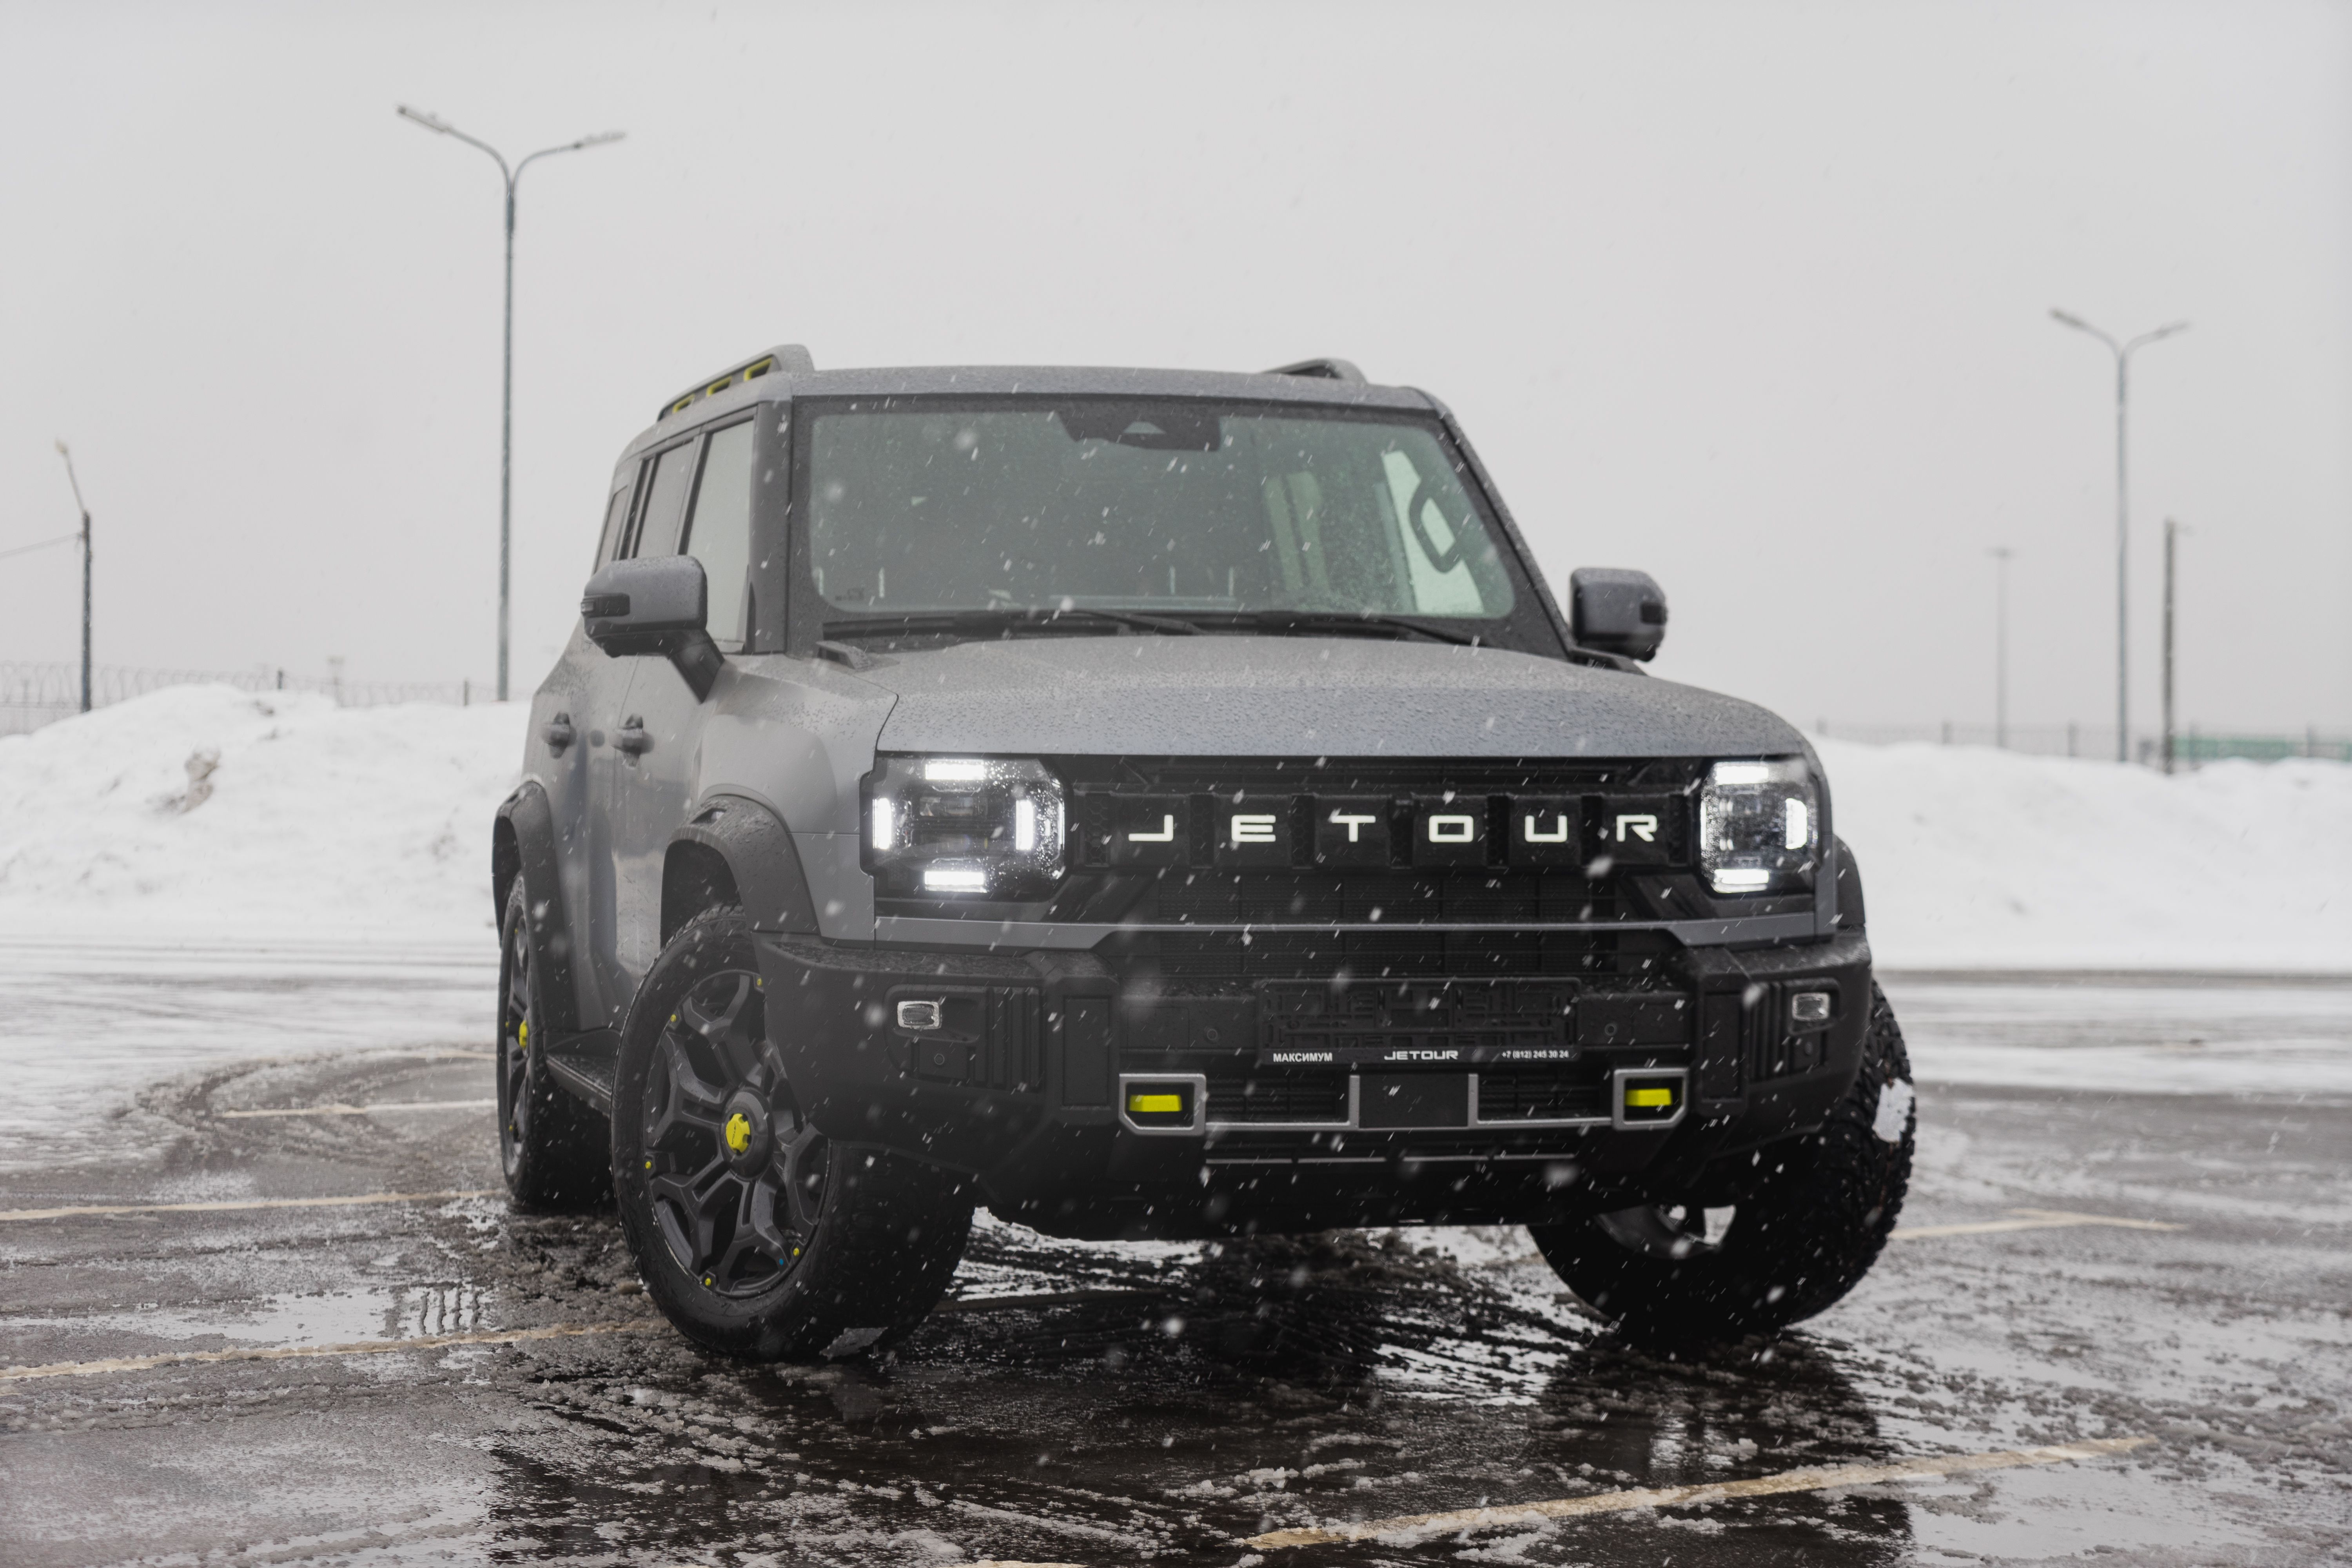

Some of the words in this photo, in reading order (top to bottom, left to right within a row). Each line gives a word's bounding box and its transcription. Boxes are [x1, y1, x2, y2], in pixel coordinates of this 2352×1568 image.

[1128, 815, 1657, 842] JETOUR
[1273, 1052, 1333, 1062] МАКСИМУМ
[1384, 1050, 1459, 1060] JETOUR
[1501, 1050, 1511, 1058] +7
[1548, 1050, 1558, 1058] 30
